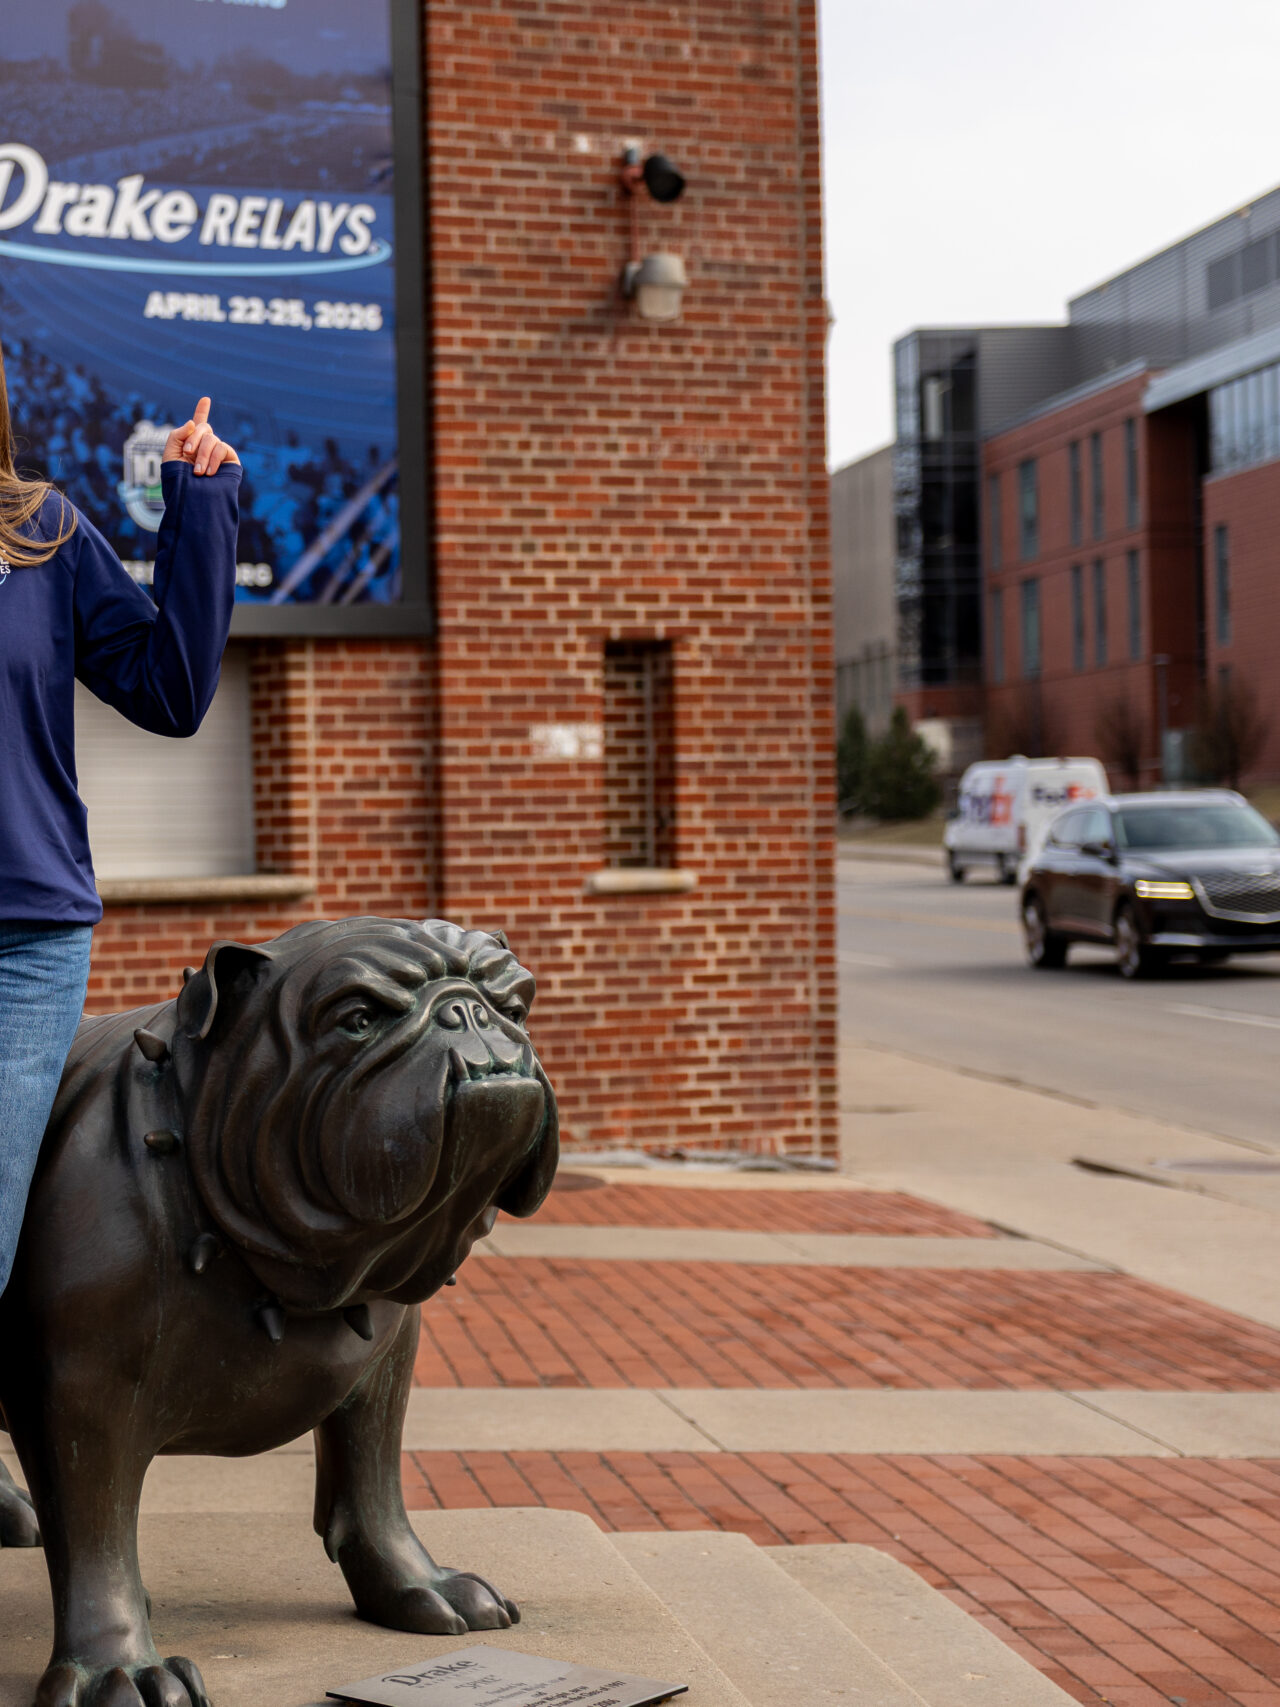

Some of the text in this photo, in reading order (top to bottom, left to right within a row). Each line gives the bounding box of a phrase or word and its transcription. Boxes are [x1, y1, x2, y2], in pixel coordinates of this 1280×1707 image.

[200, 194, 376, 255] RELAYS
[144, 291, 383, 331] APRIL 22-25, 2026
[381, 1660, 479, 1686] Drake
